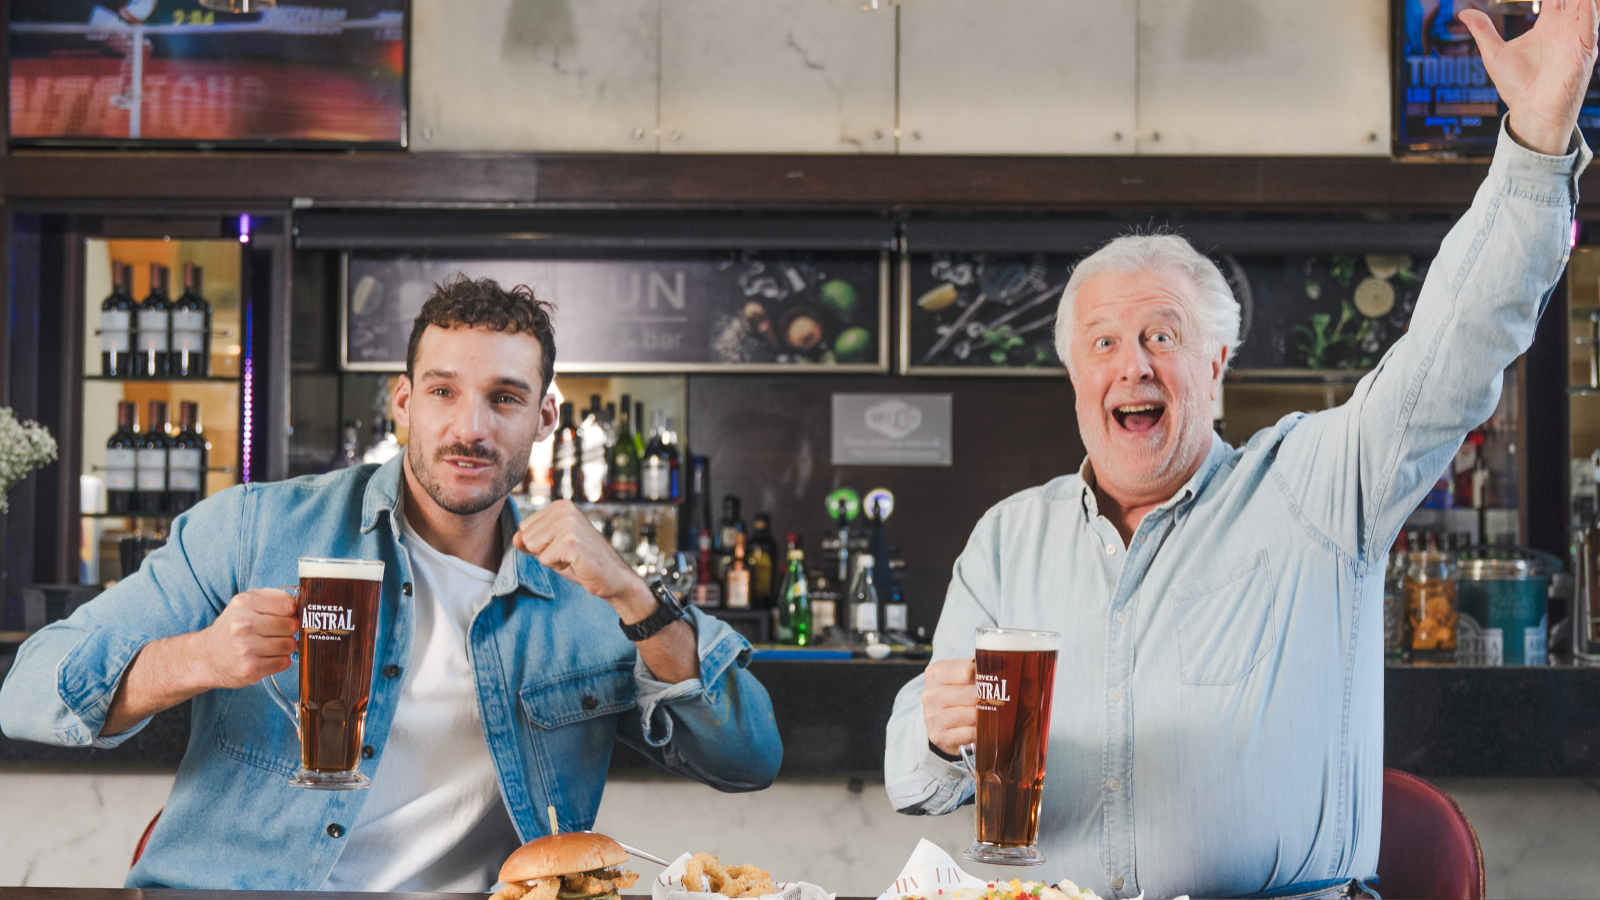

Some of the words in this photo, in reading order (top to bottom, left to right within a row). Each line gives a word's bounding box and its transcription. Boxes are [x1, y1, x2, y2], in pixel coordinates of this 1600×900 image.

[1407, 56, 1487, 86] TODOS
[302, 607, 355, 631] AUSTRAL
[975, 679, 1010, 701] STRAL
